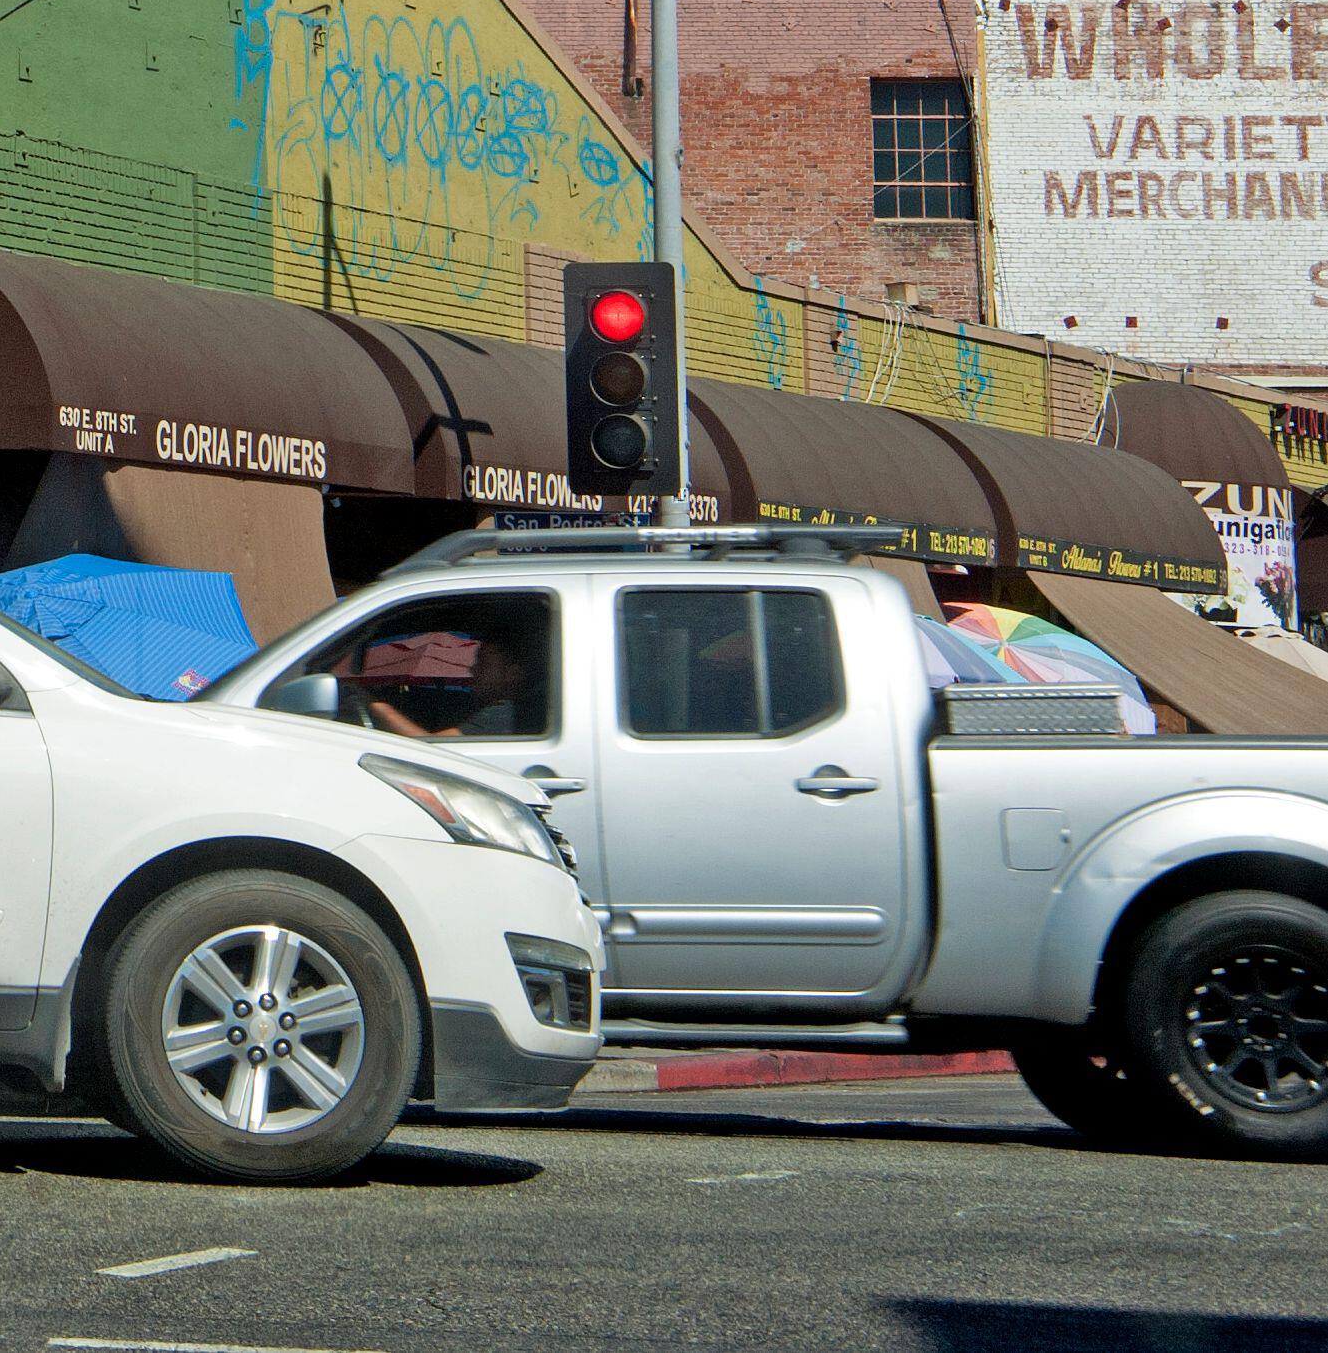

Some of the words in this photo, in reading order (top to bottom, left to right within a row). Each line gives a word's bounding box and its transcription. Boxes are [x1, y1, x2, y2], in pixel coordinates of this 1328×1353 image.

[1044, 170, 1328, 221] MERCHAN
[59, 406, 80, 427] 630
[82, 408, 93, 429] E.
[95, 410, 117, 432] 8TH
[120, 413, 137, 435] ST.
[76, 430, 104, 453] UNIT
[105, 433, 114, 454] A
[156, 419, 231, 466] GLORIA
[236, 430, 326, 479] FLOWERS
[463, 464, 524, 503] GLORIA
